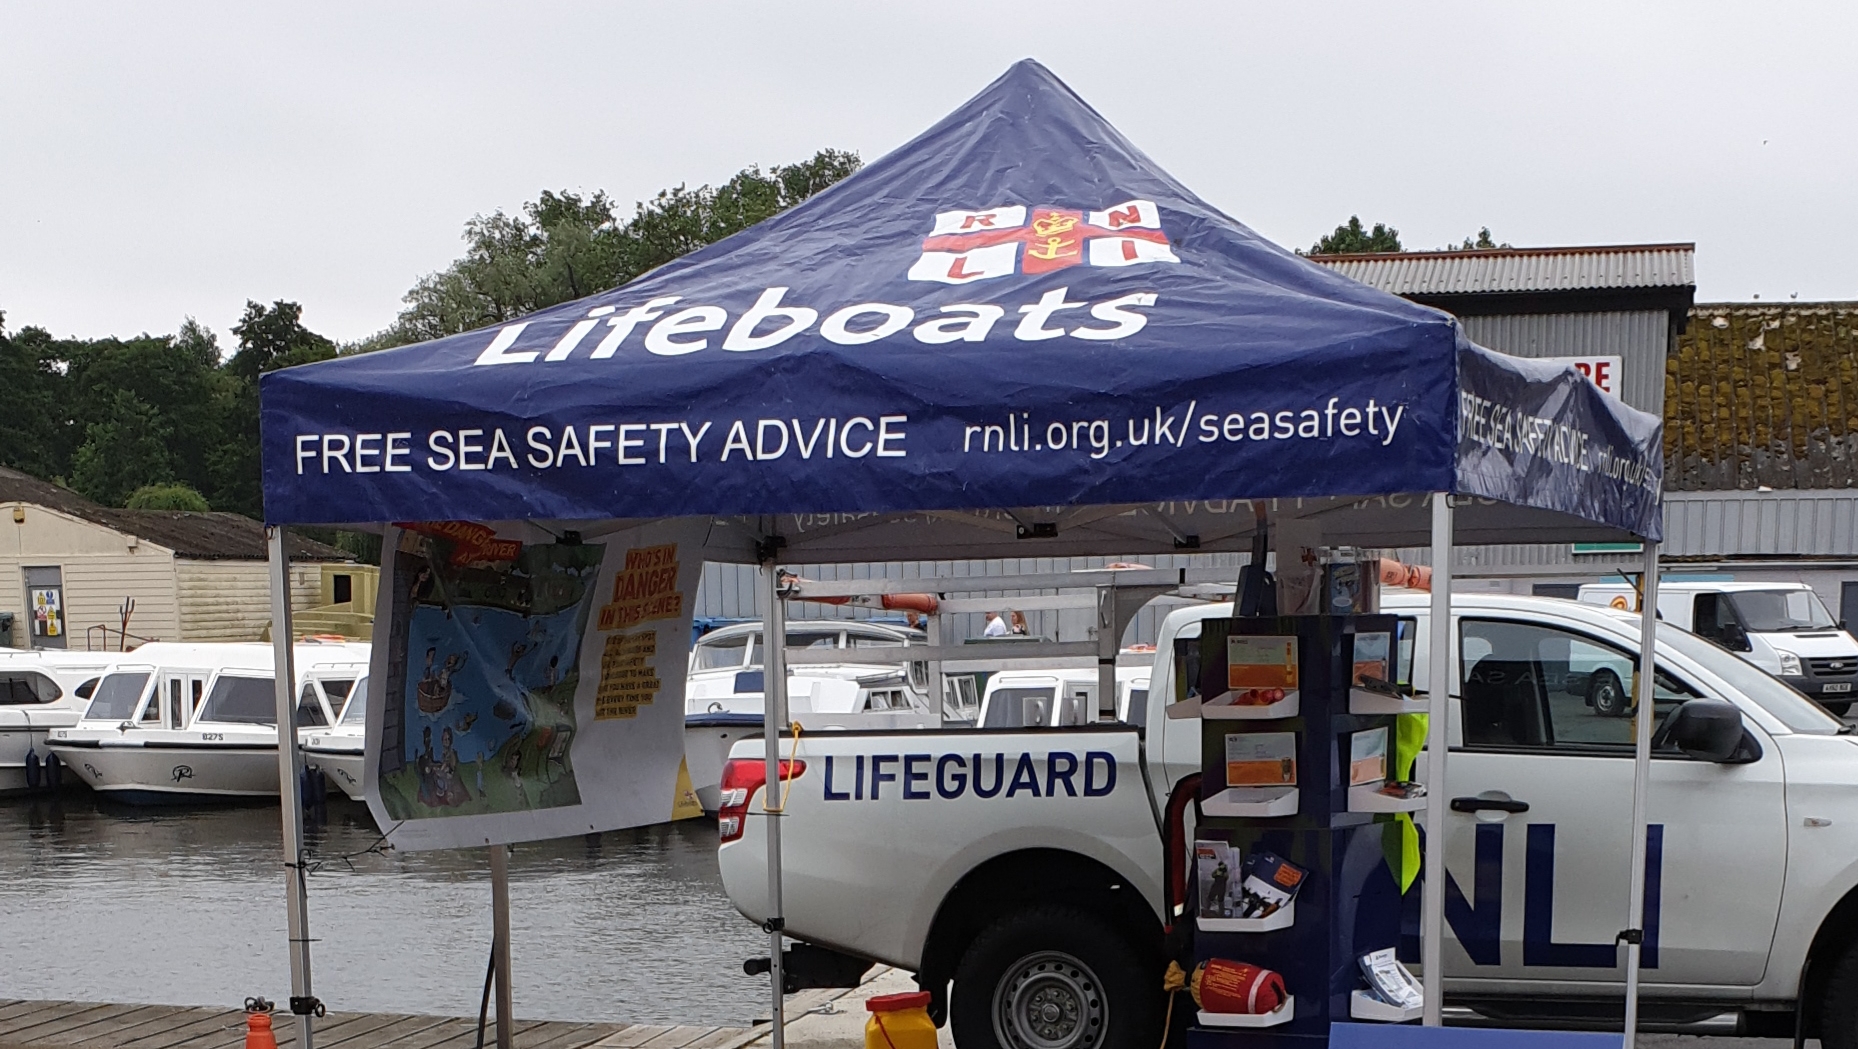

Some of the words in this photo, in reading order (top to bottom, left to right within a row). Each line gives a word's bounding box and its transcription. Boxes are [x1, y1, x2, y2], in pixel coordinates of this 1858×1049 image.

[960, 213, 997, 229] R
[1109, 205, 1142, 228] N
[947, 257, 985, 279] L
[474, 287, 1159, 367] Lifeboats
[296, 432, 412, 475] FREE
[427, 427, 519, 471] SEA
[527, 420, 712, 469] SAFETY
[720, 415, 907, 462] ADVICE
[963, 396, 1405, 459] rnli.org.uk/seasafety
[1461, 391, 1487, 443] FREE
[1488, 401, 1513, 450] SEA
[662, 547, 676, 566] IN
[613, 567, 677, 602] DANGER
[600, 608, 616, 625] IN
[823, 751, 1118, 801] LIFEGUARD
[1400, 822, 1664, 969] NLI
